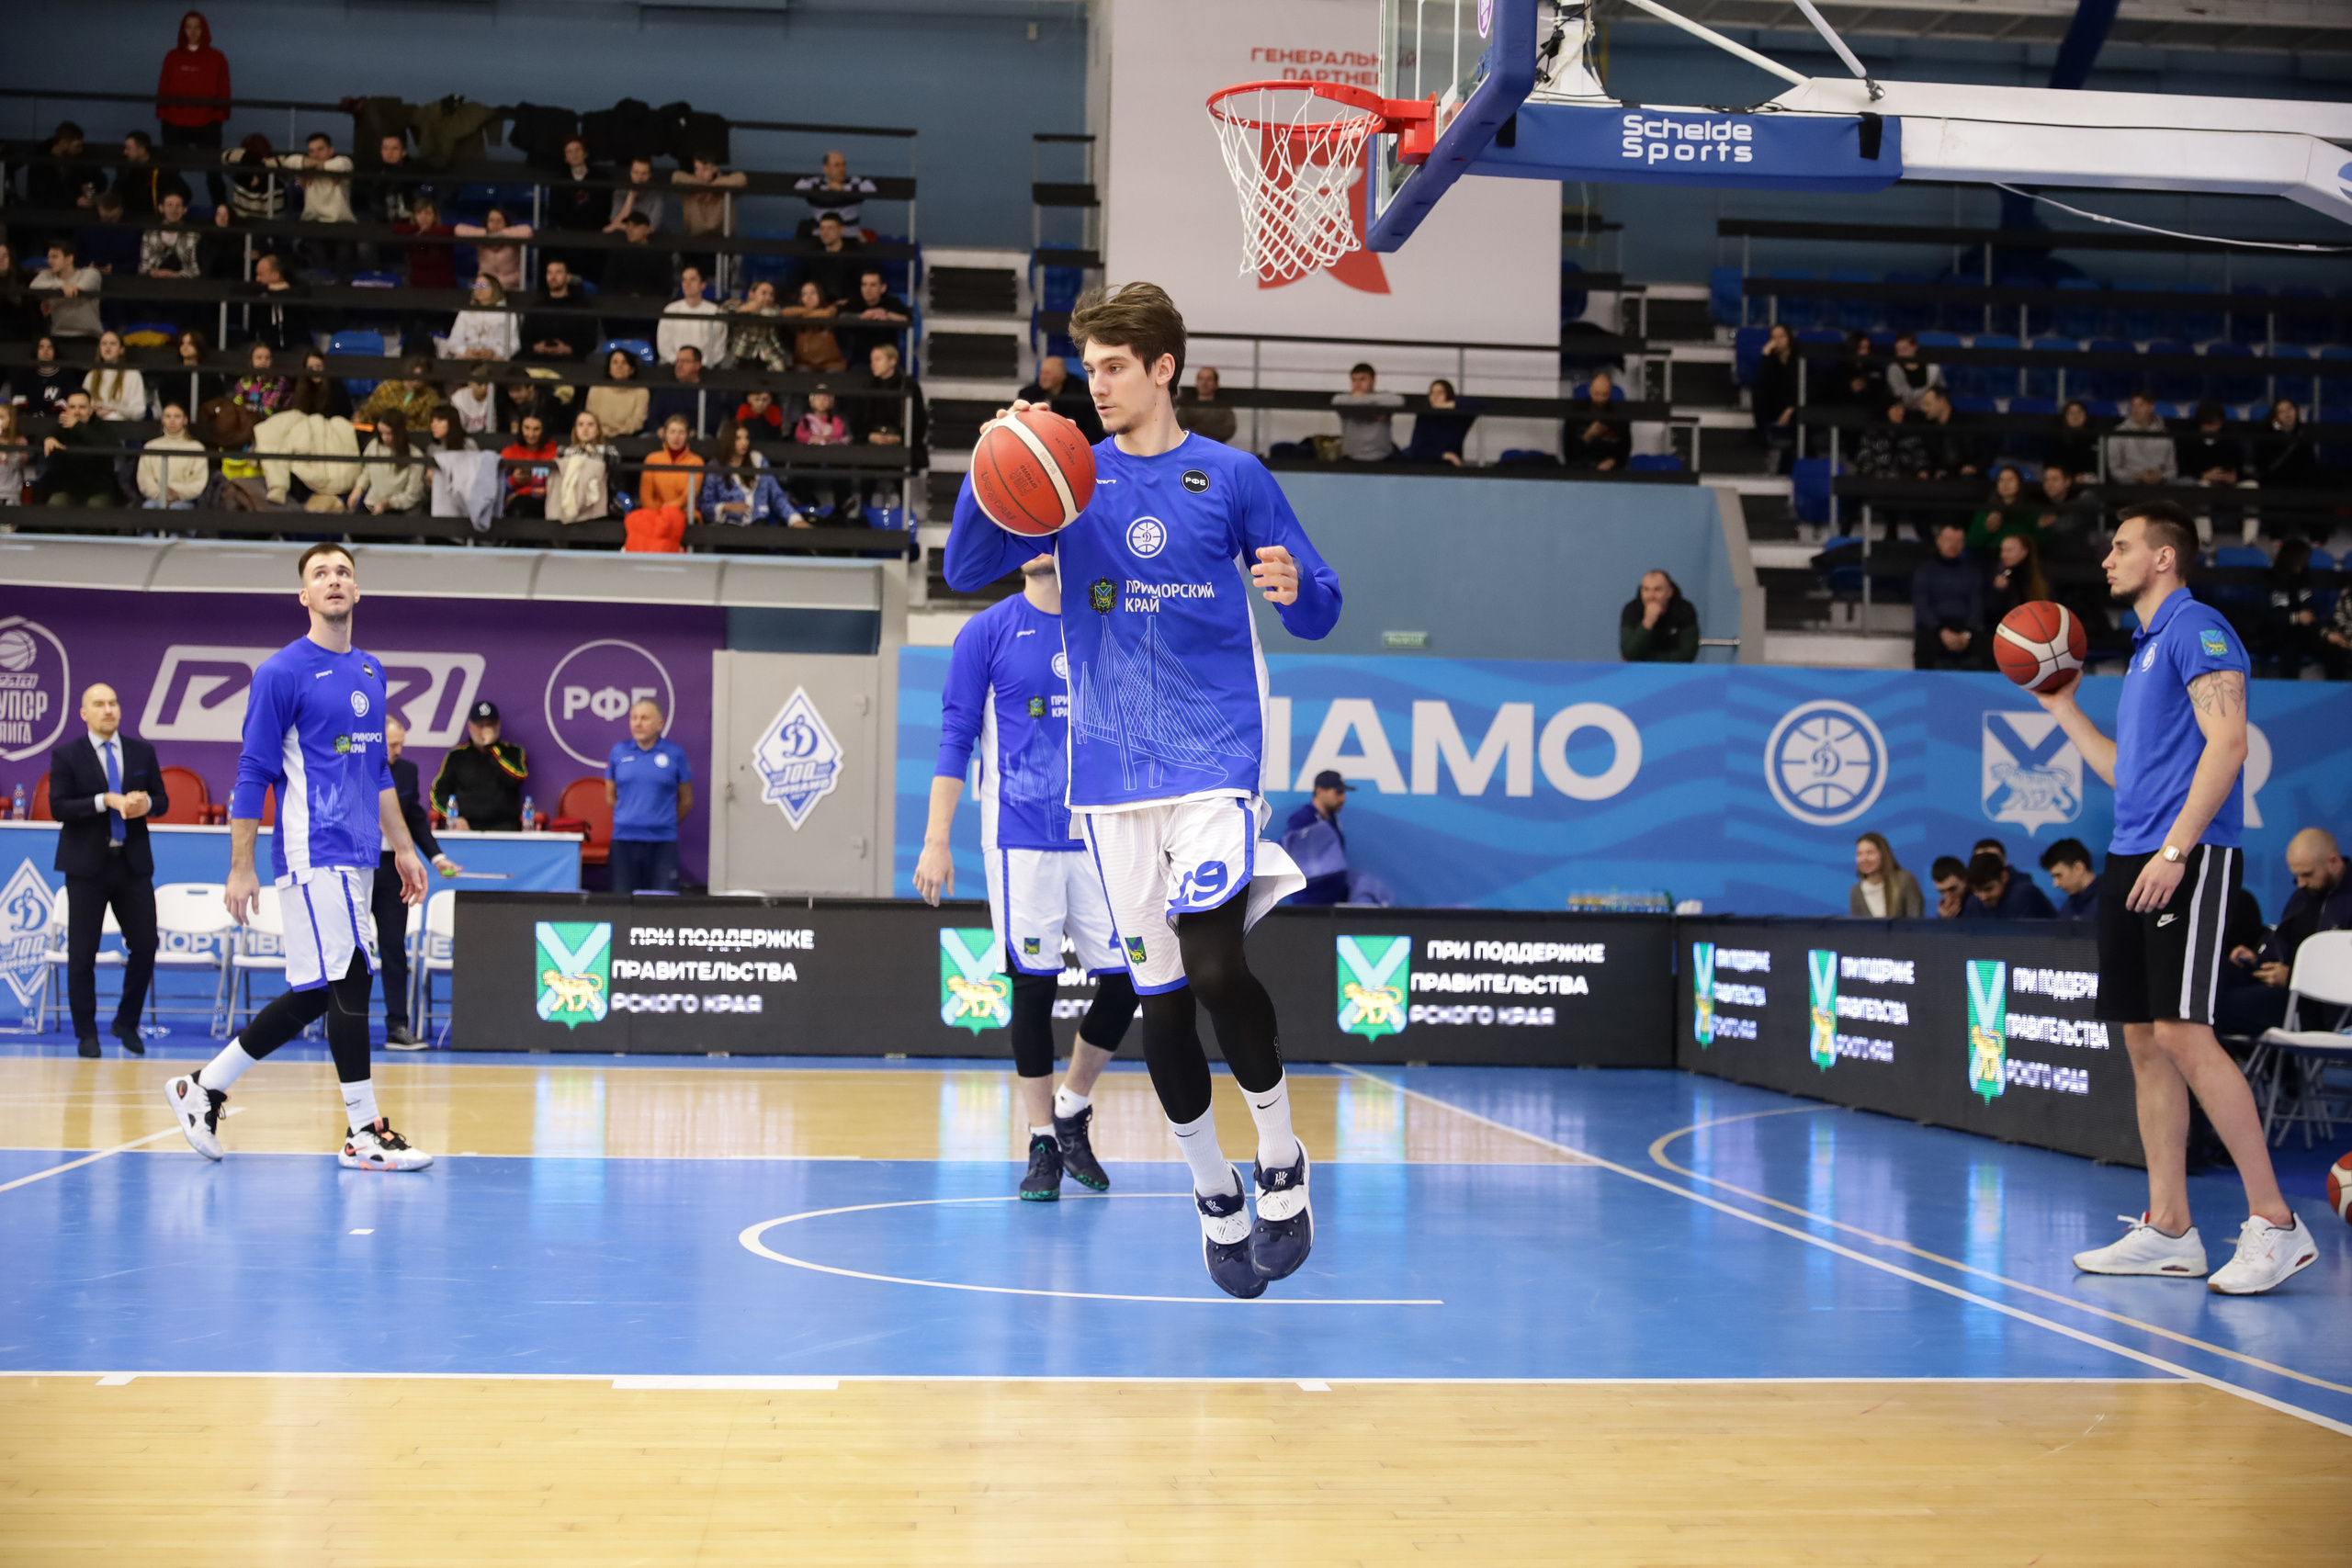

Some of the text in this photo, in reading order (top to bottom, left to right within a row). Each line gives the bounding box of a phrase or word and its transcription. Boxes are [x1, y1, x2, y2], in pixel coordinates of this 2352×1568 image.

[1283, 68, 1379, 85] ПАРТНЕ
[1623, 115, 1753, 141] Schelde
[1623, 137, 1753, 164] Sports
[1009, 468, 1034, 497] FIBA
[1185, 477, 1206, 487] РФБ
[980, 470, 1016, 521] molten
[1125, 580, 1215, 598] ПРИМОРСКИЙ
[1125, 595, 1159, 614] КРАЙ
[155, 660, 466, 733] PRI
[1051, 707, 1069, 717] КРА
[1265, 696, 1643, 801] АМО
[629, 927, 815, 952] ПРИ ПОДДЕРЖКЕ
[1427, 940, 1606, 964] ПРИ ПОДДЕРЖКЕ
[611, 959, 797, 982] ПРАВИТЕЛЬСТВА
[1409, 972, 1589, 995] ПРАВИТЕЛЬСТВА
